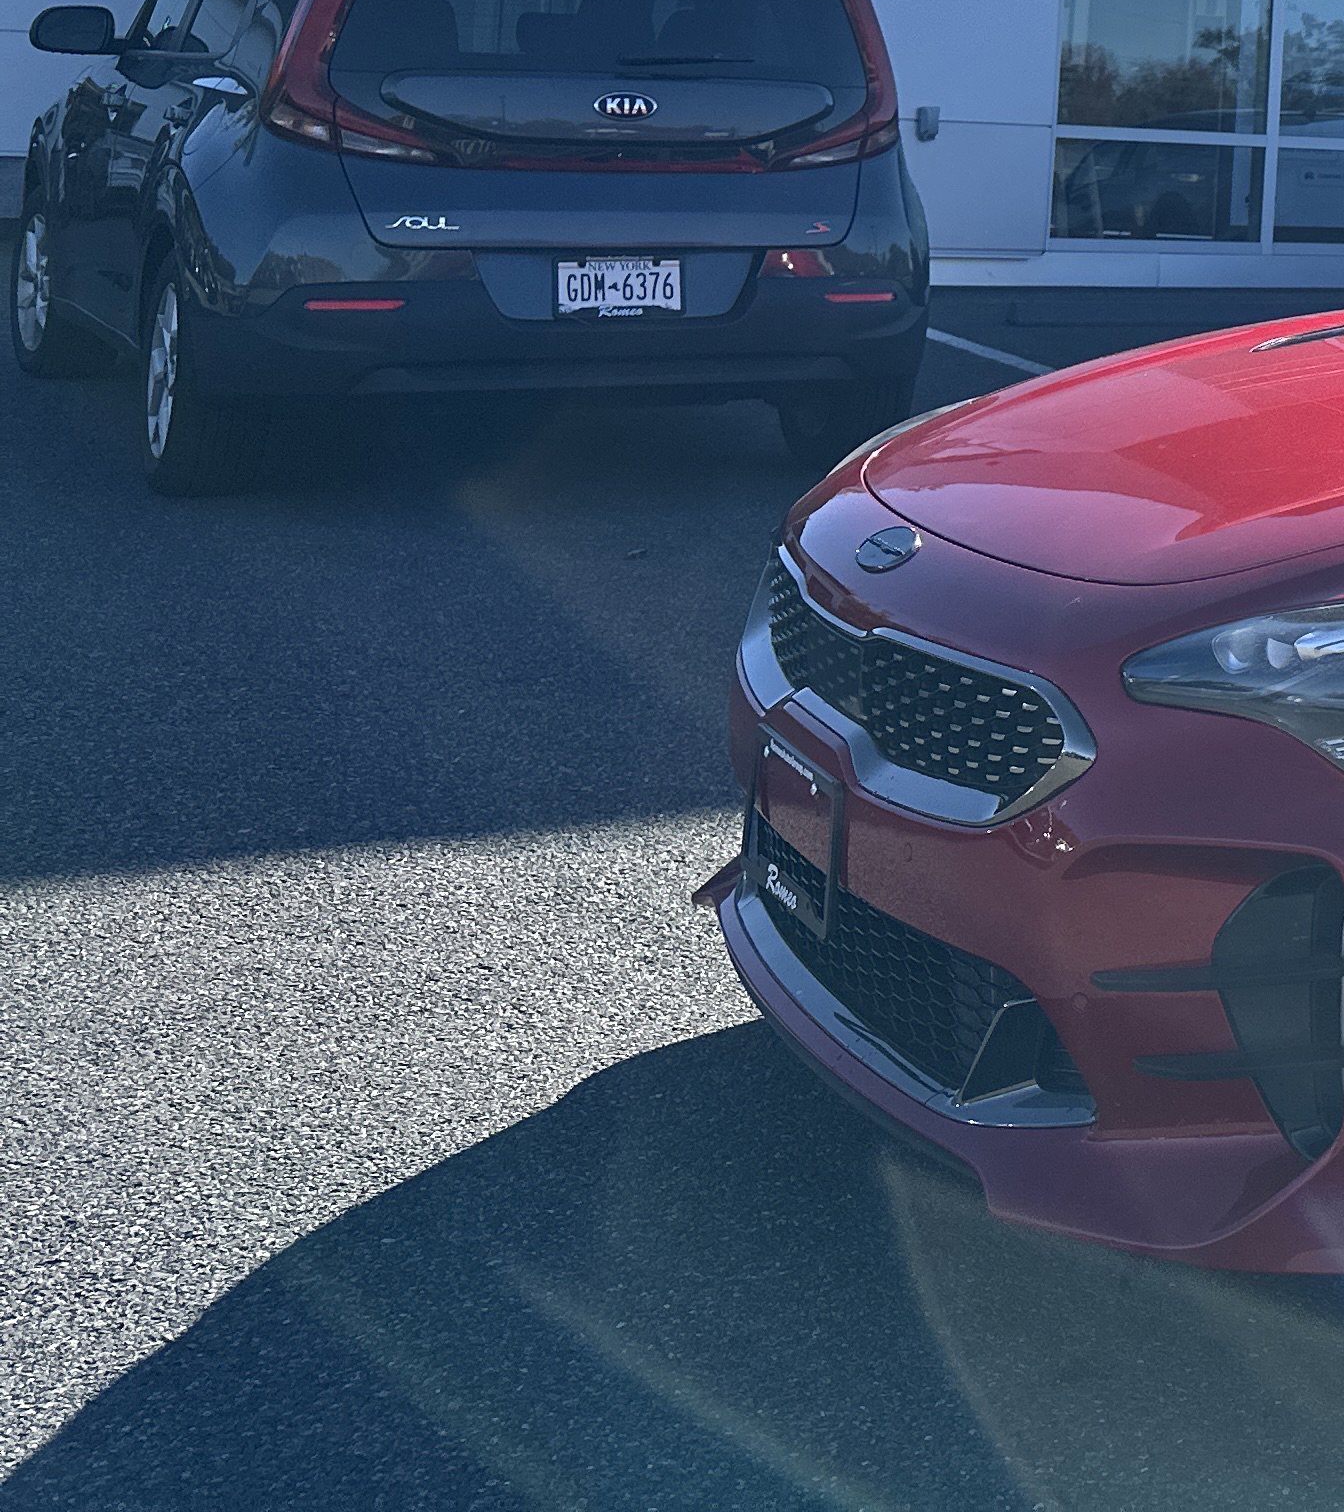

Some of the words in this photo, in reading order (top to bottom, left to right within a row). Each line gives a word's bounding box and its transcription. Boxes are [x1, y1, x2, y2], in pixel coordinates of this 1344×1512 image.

[606, 97, 648, 115] KIA
[385, 216, 460, 229] SOUL
[587, 262, 617, 271] NEW
[620, 261, 651, 270] YORK
[766, 863, 797, 909] Romeo
